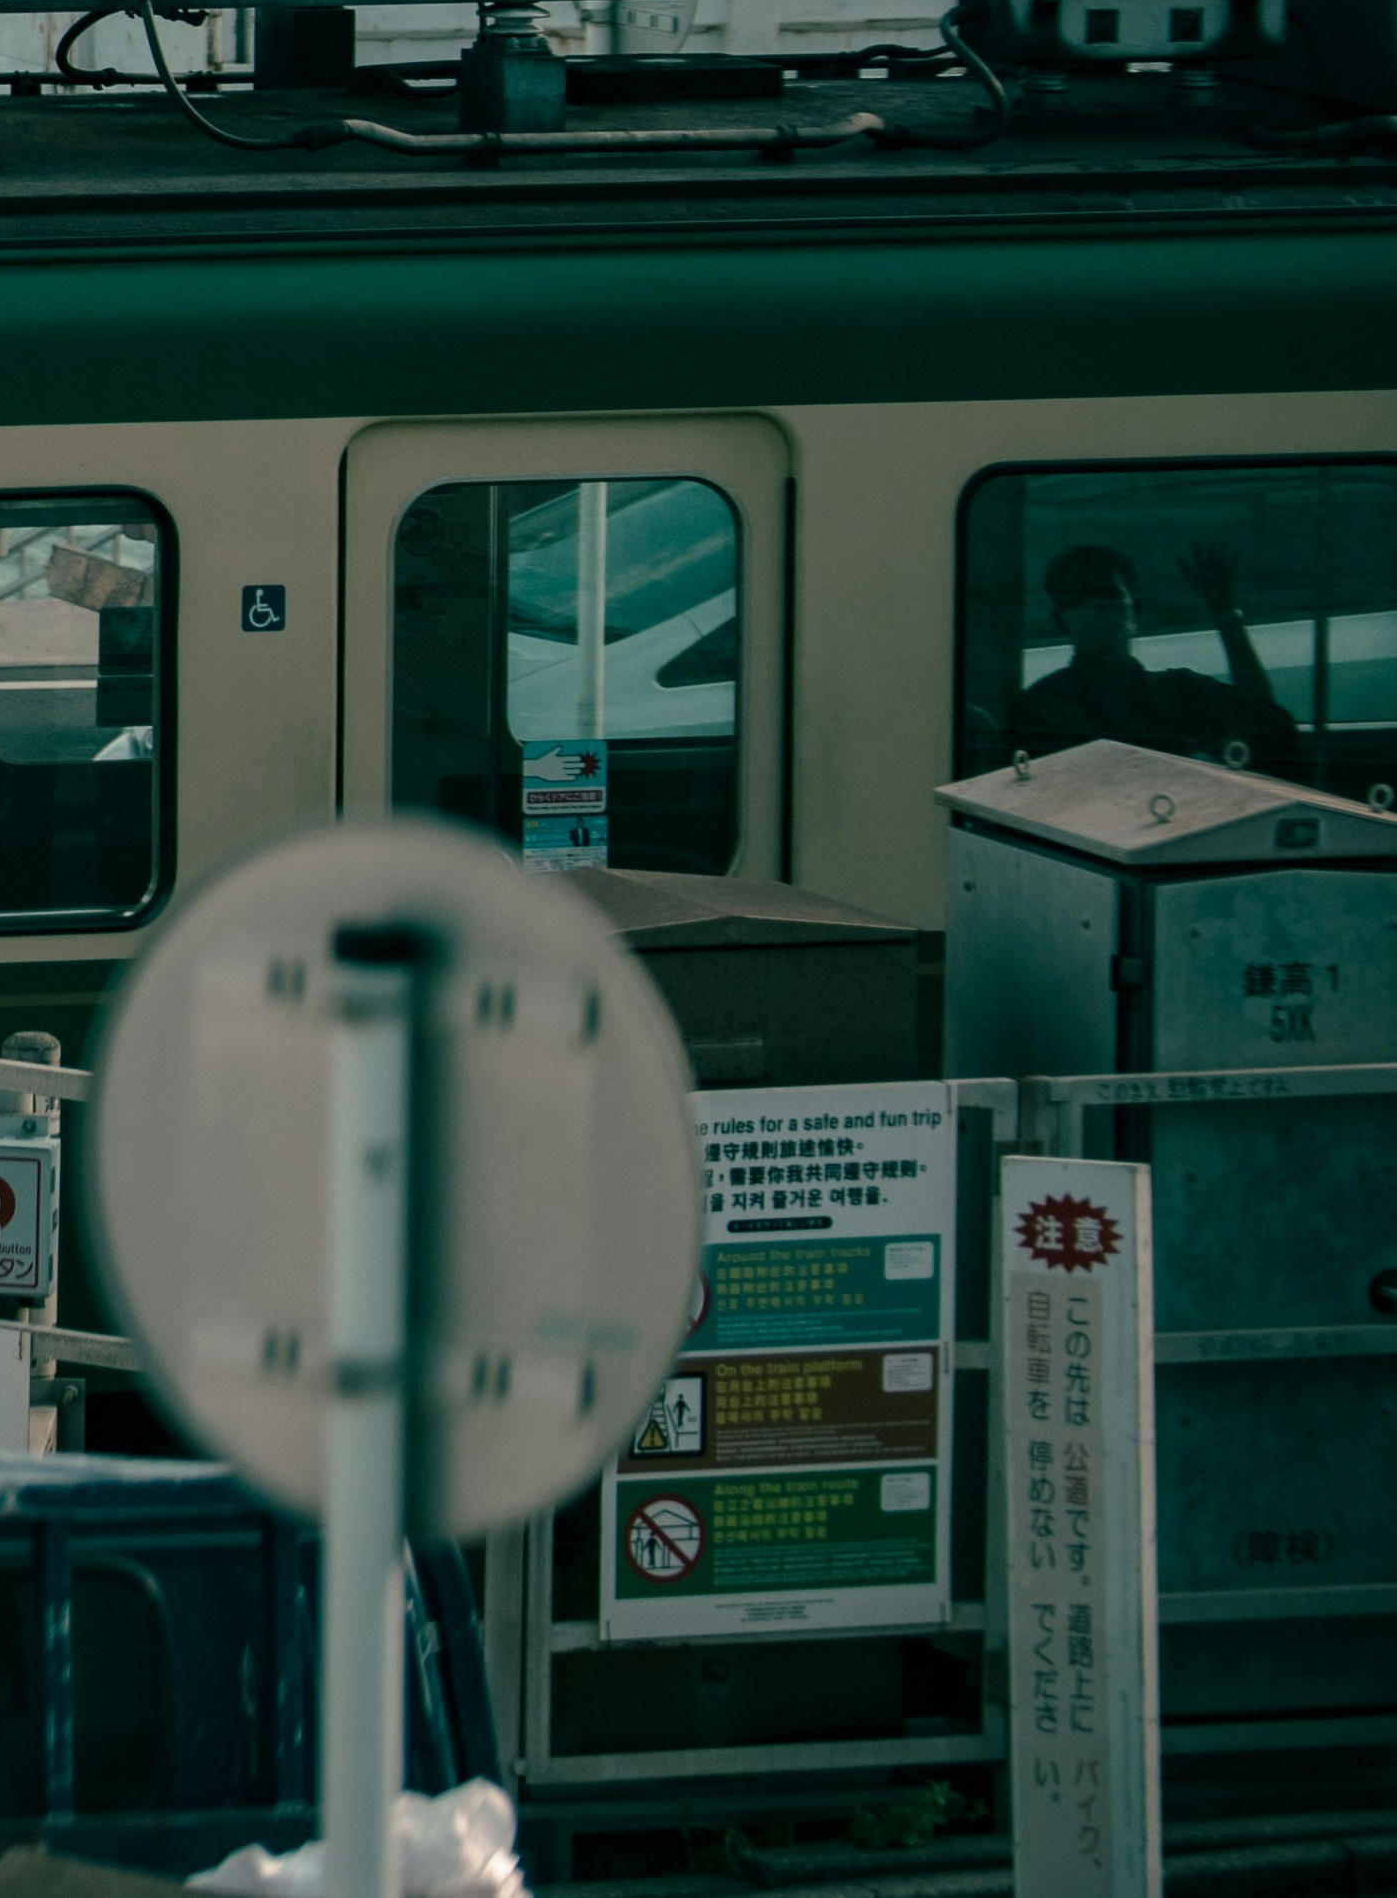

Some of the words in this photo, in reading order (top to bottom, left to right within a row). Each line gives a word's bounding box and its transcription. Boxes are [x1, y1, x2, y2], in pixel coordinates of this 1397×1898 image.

[713, 1118, 755, 1135] rules
[760, 1115, 783, 1132] for
[788, 1119, 797, 1131] a
[803, 1112, 839, 1130] safe
[844, 1111, 875, 1128] and
[880, 1110, 907, 1127] fun
[912, 1108, 942, 1129] trip
[732, 1190, 765, 1212] 지켜
[1034, 1215, 1104, 1253] 注意
[0, 1242, 32, 1256] button
[716, 1364, 737, 1377] On
[741, 1363, 763, 1375] the
[767, 1362, 799, 1374] train
[803, 1359, 863, 1375] platform
[714, 1483, 755, 1498] Along
[759, 1482, 782, 1494] the
[786, 1481, 818, 1492] train
[822, 1478, 859, 1490] route
